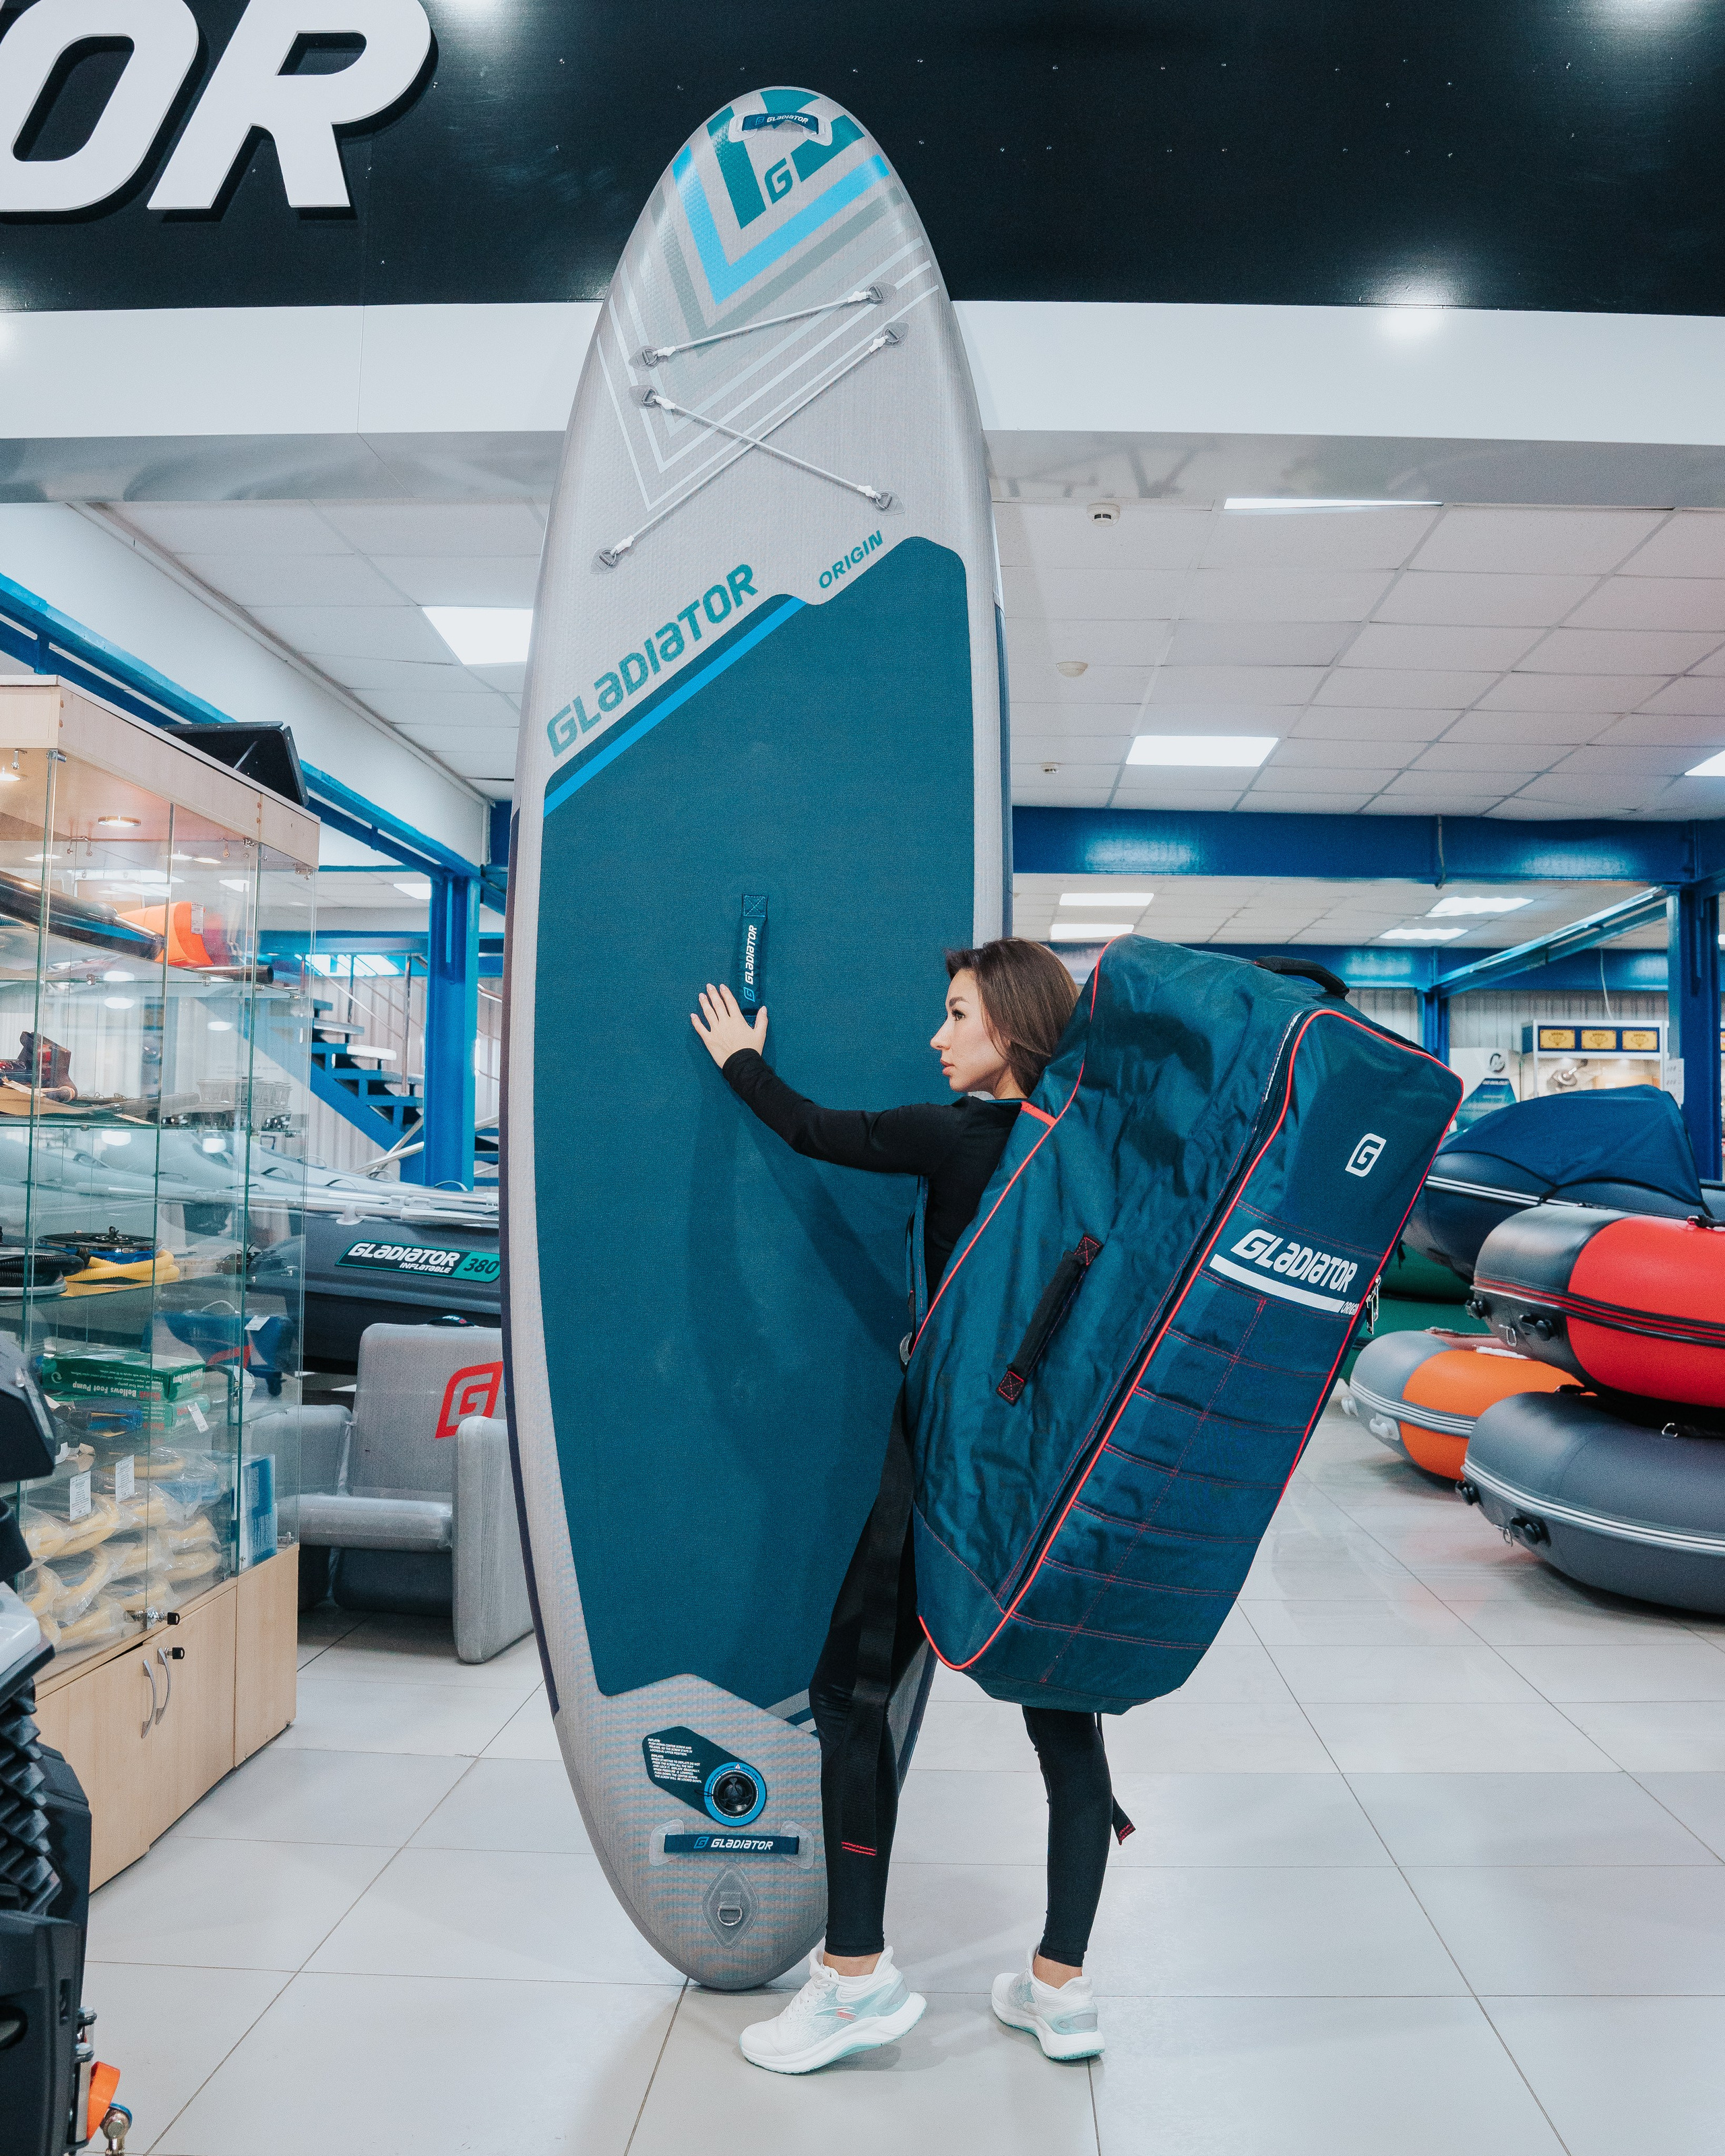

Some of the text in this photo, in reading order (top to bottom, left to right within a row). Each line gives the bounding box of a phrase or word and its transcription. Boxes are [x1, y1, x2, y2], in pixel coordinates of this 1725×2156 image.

[819, 530, 883, 589] ORIGIN
[348, 1242, 499, 1274] GLADIATOR 380
[399, 1262, 452, 1273] INFLATABLE
[72, 1381, 92, 1392] Pump
[93, 1385, 108, 1394] Foot
[110, 1387, 137, 1397] Bellows
[711, 1839, 773, 1850] GLADIATOR
